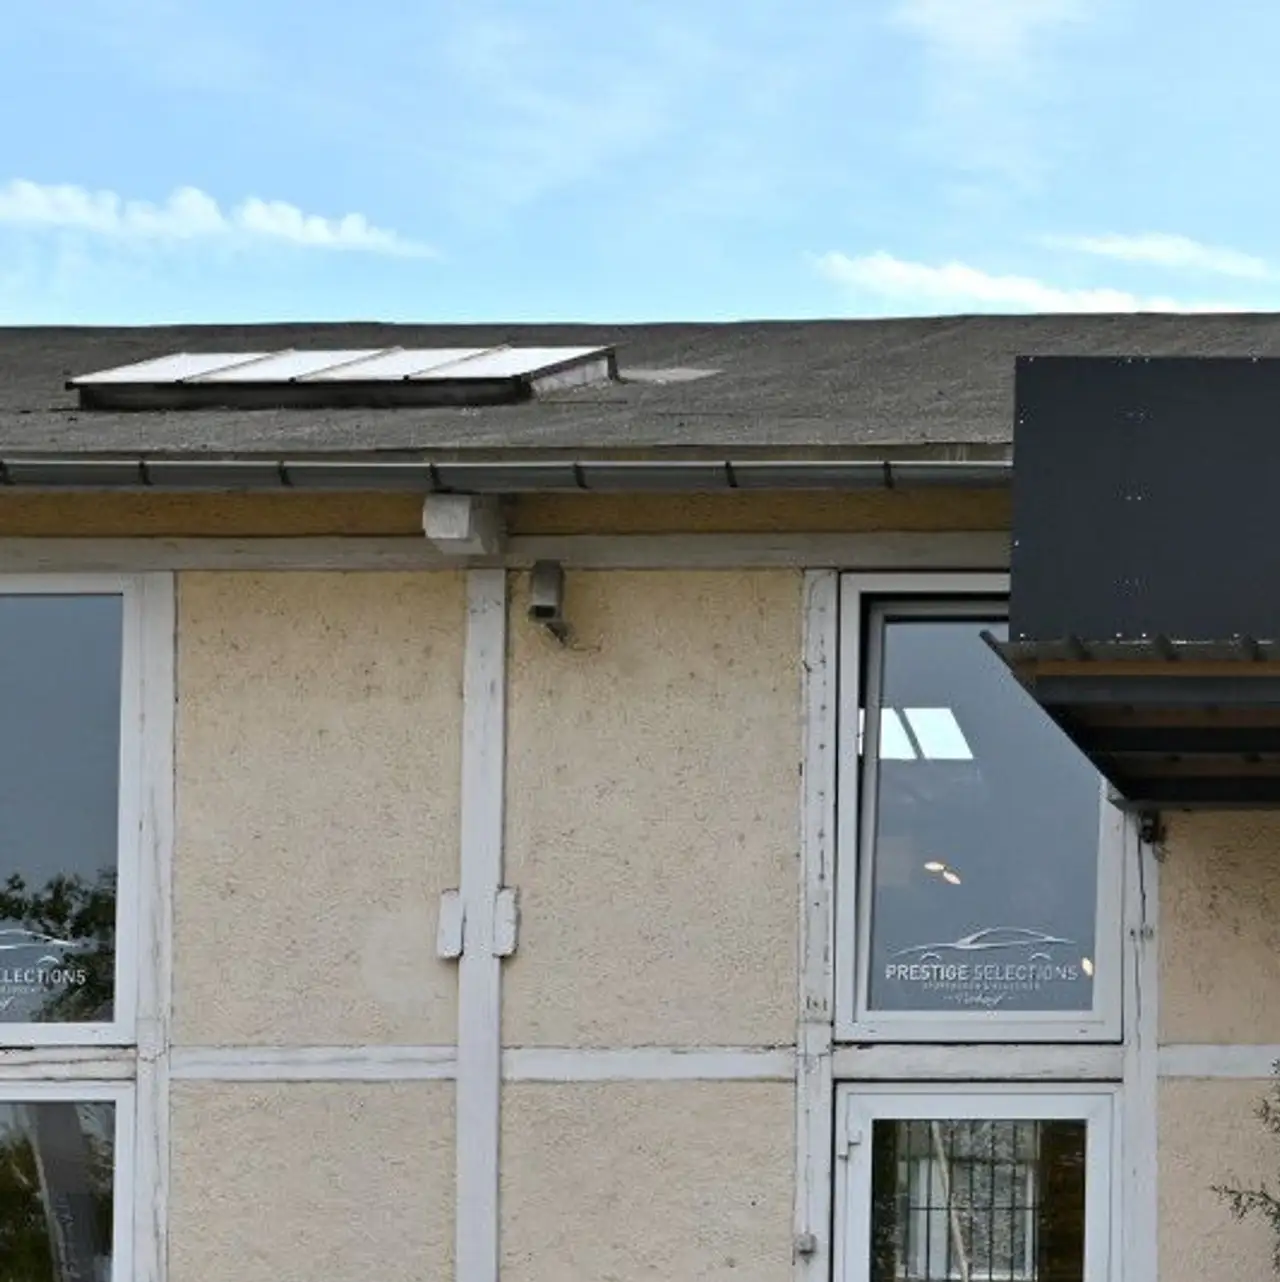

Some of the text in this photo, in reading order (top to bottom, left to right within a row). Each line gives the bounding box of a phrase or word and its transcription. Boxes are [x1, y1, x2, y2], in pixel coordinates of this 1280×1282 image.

[0, 967, 87, 986] LECTIONS
[885, 964, 1079, 982] PRESTIGE SELECTIONS
